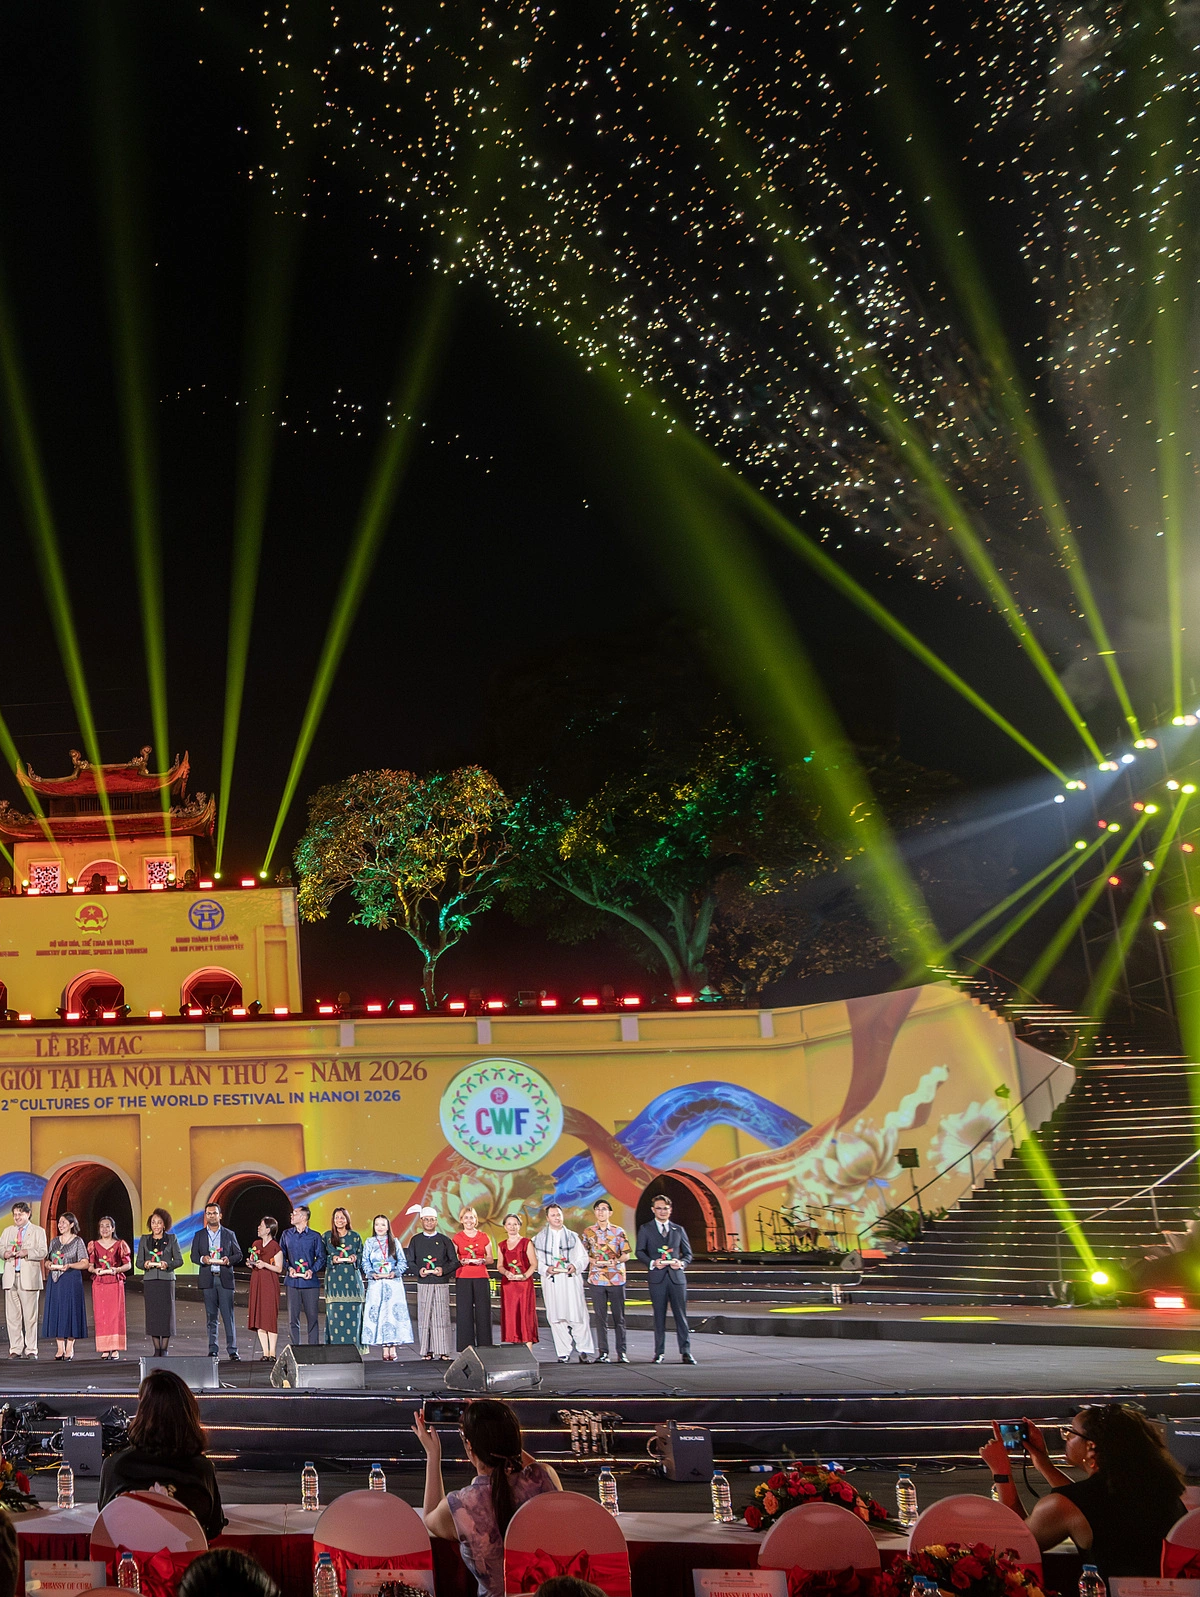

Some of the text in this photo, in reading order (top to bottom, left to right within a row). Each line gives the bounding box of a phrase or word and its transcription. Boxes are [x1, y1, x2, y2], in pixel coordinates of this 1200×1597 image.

[97, 1036, 143, 1058] MẠC
[0, 1066, 42, 1091] GIỚI
[48, 1069, 81, 1092] TẠI
[87, 1064, 118, 1088] HÀ
[123, 1063, 161, 1090] NỘI
[274, 1063, 288, 1084] 2
[369, 1060, 428, 1082] 2026
[20, 1097, 90, 1110] CULTURES
[94, 1096, 114, 1109] OF
[118, 1095, 147, 1108] THE
[151, 1094, 209, 1107] WORLD
[213, 1092, 285, 1106] FESTIVAL
[289, 1092, 304, 1104] IN
[309, 1090, 359, 1103] HANOI
[364, 1089, 401, 1102] 2026
[475, 1107, 529, 1136] CWF
